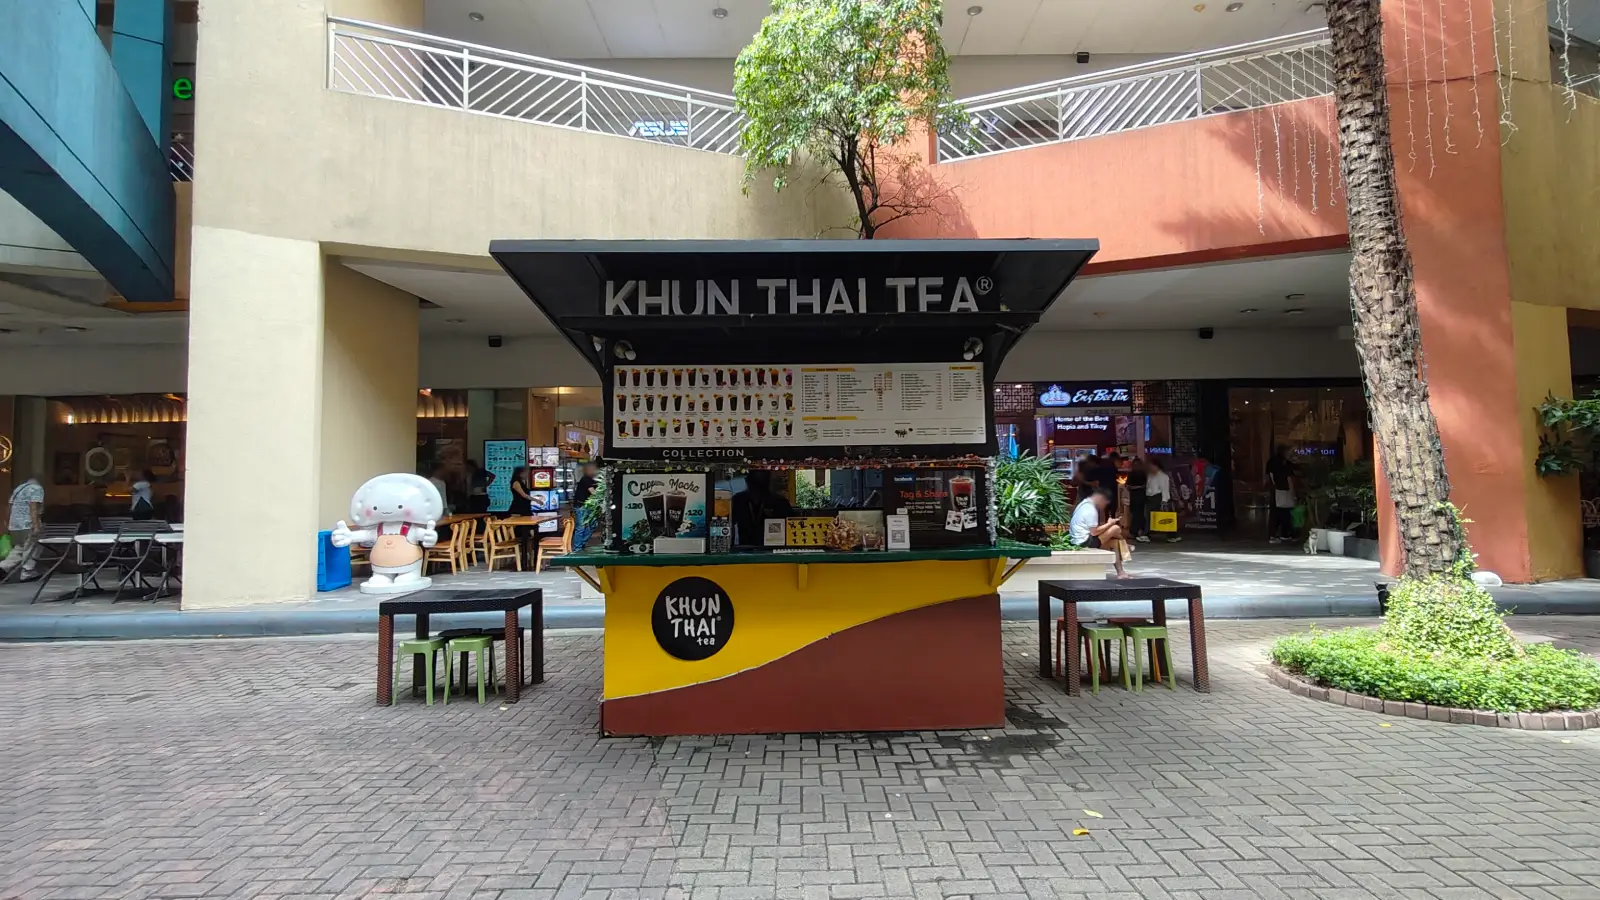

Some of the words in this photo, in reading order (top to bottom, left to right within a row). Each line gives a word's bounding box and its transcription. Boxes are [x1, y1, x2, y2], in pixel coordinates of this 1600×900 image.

[605, 279, 740, 316] KHUN
[756, 278, 867, 314] THAI
[1072, 389, 1094, 404] Eng
[1093, 389, 1113, 401] Bee
[1112, 388, 1129, 401] Tin
[662, 449, 744, 458] COLLECTION
[669, 478, 700, 493] Mocha
[899, 490, 914, 499] Tag
[1195, 492, 1216, 509] #1
[665, 593, 721, 620] KHUN
[671, 617, 716, 638] THAI
[696, 636, 715, 646] tea
